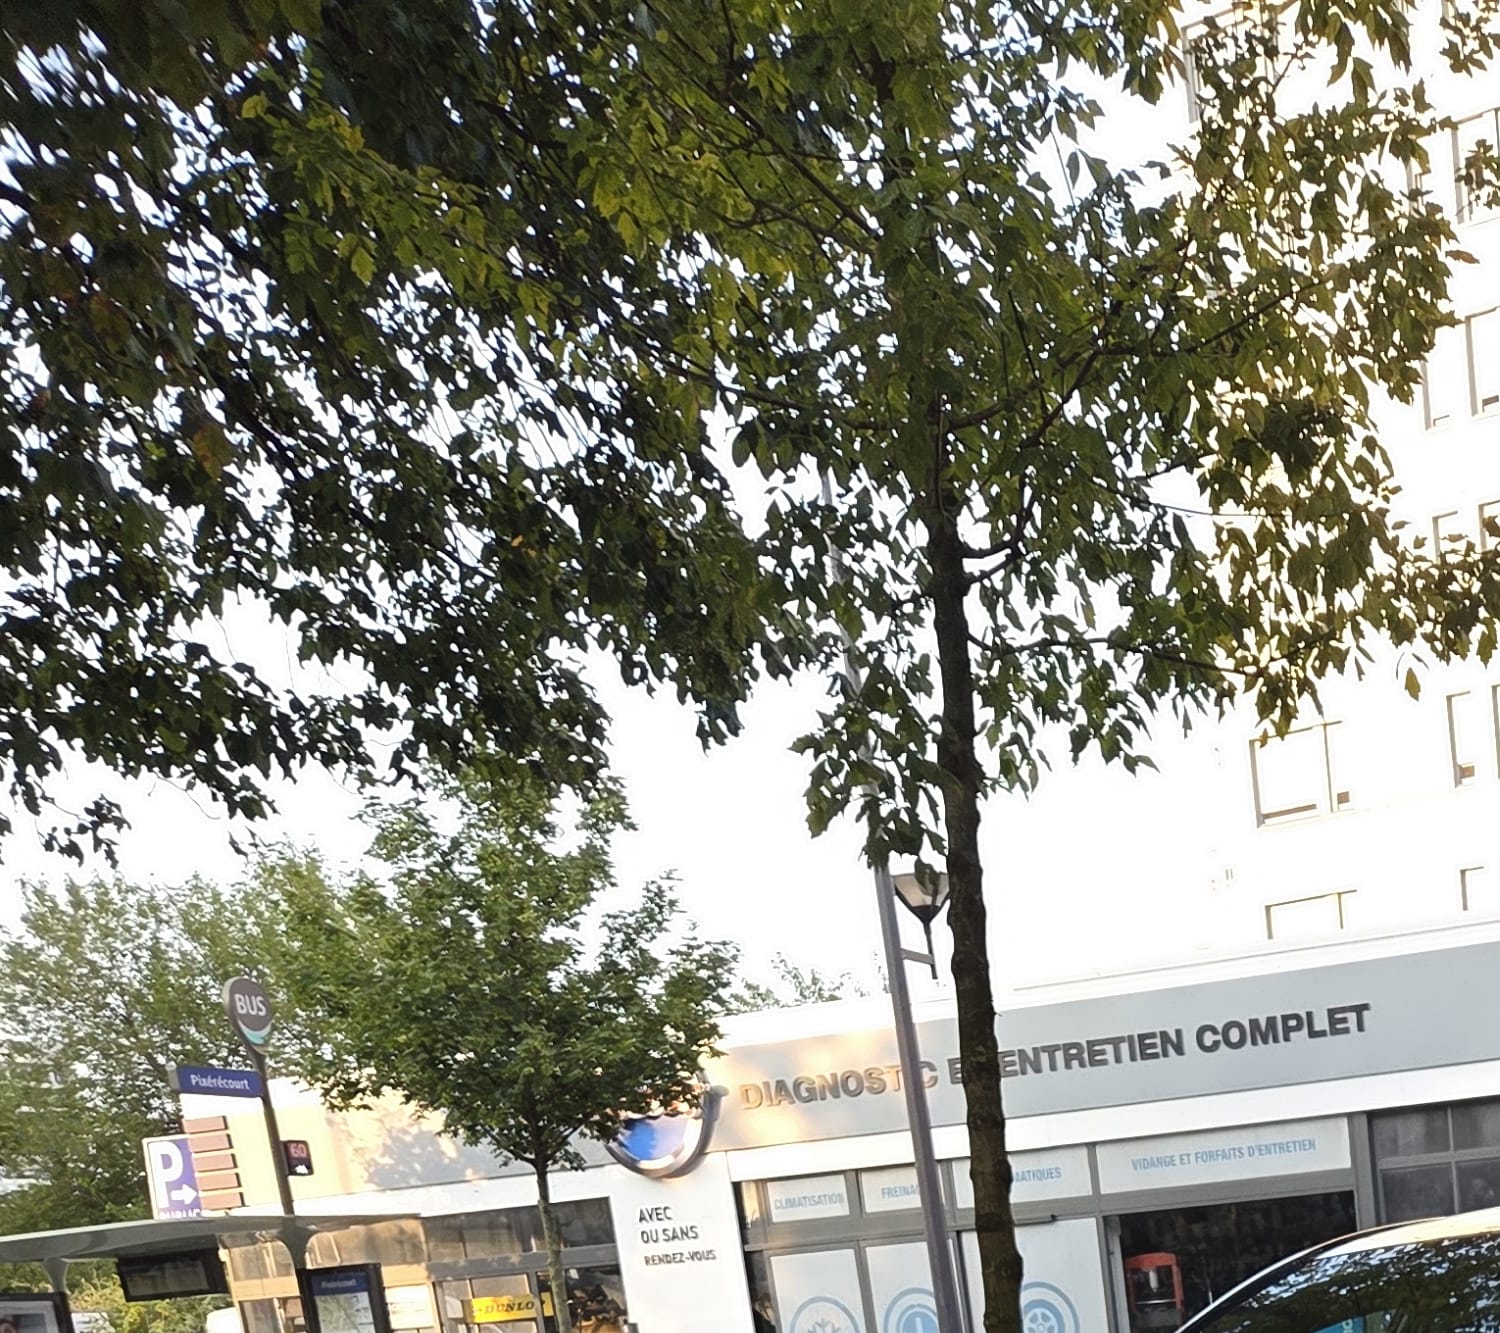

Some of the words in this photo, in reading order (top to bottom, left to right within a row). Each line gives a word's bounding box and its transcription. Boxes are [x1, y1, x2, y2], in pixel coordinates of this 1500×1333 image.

[234, 993, 267, 1017] BUS
[740, 1060, 939, 1110] DIAGNOSTC
[947, 1057, 963, 1085] E
[998, 1028, 1186, 1078] ENTRETIEN
[1195, 1003, 1371, 1053] COMPLET
[190, 1073, 250, 1090] Pixérécourt
[290, 1143, 307, 1158] 60
[1131, 1154, 1177, 1171] VIDANGE
[1179, 1152, 1192, 1166] ET
[1195, 1146, 1245, 1165] FORFAITS
[1248, 1138, 1317, 1158] D'ENTRETIEN
[148, 1140, 184, 1208] P
[1015, 1166, 1062, 1184] ATIQUES
[881, 1183, 920, 1199] FREINA
[774, 1192, 845, 1211] CLIMATISATION
[638, 1206, 673, 1224] AVEC
[640, 1229, 659, 1244] OU
[663, 1225, 699, 1243] SANS
[644, 1249, 717, 1266] RENDEZ-VOUS
